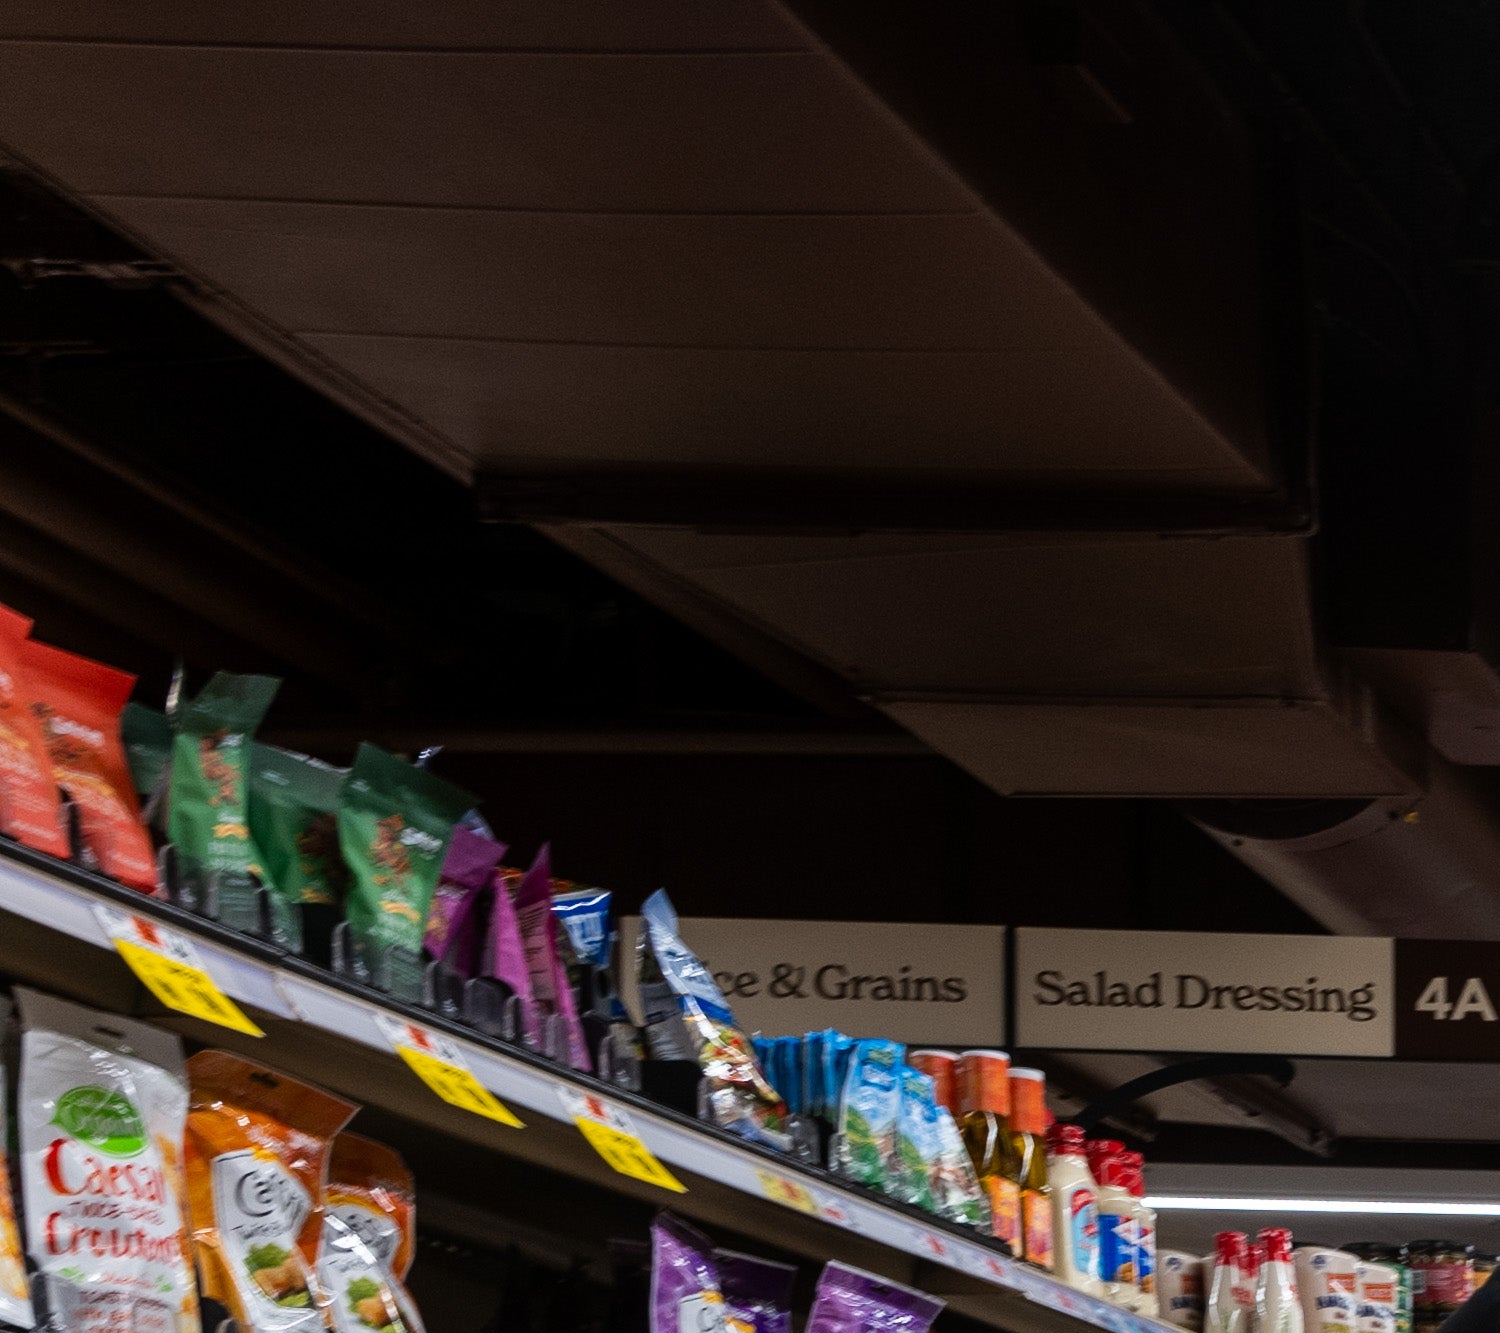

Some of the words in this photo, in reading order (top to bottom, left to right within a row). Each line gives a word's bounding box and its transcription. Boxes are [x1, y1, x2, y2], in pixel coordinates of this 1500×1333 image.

[768, 964, 803, 1000] &
[813, 964, 968, 1004] Grains
[1034, 967, 1160, 1010] Salad
[1176, 974, 1377, 1022] Dressing
[1413, 976, 1499, 1023] 4A
